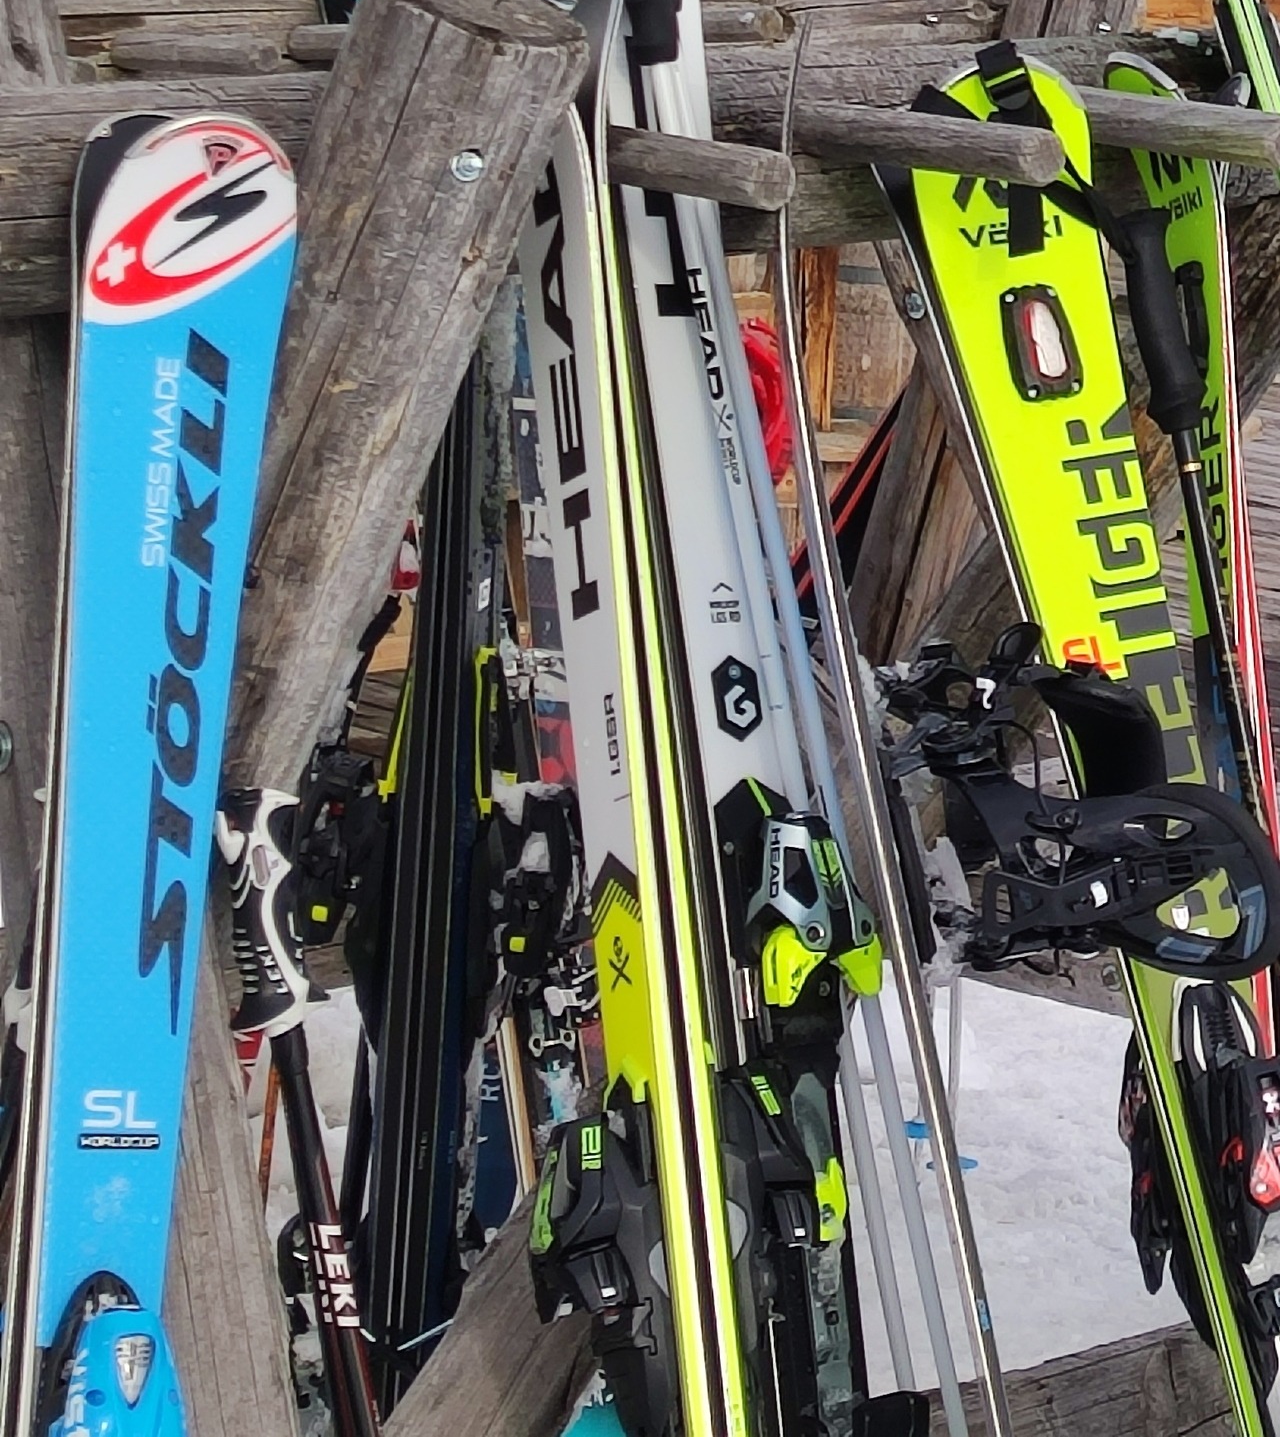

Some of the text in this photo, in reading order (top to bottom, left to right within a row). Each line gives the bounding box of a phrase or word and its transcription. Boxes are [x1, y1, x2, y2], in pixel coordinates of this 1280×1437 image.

[686, 266, 725, 403] HEAD
[142, 357, 182, 567] SWISS MADE
[138, 327, 230, 1037] STÖCKLI
[769, 825, 782, 900] HEAD
[78, 1134, 160, 1148] WORLDCUP
[82, 1088, 158, 1129] SL
[319, 1223, 360, 1328] LEKI
